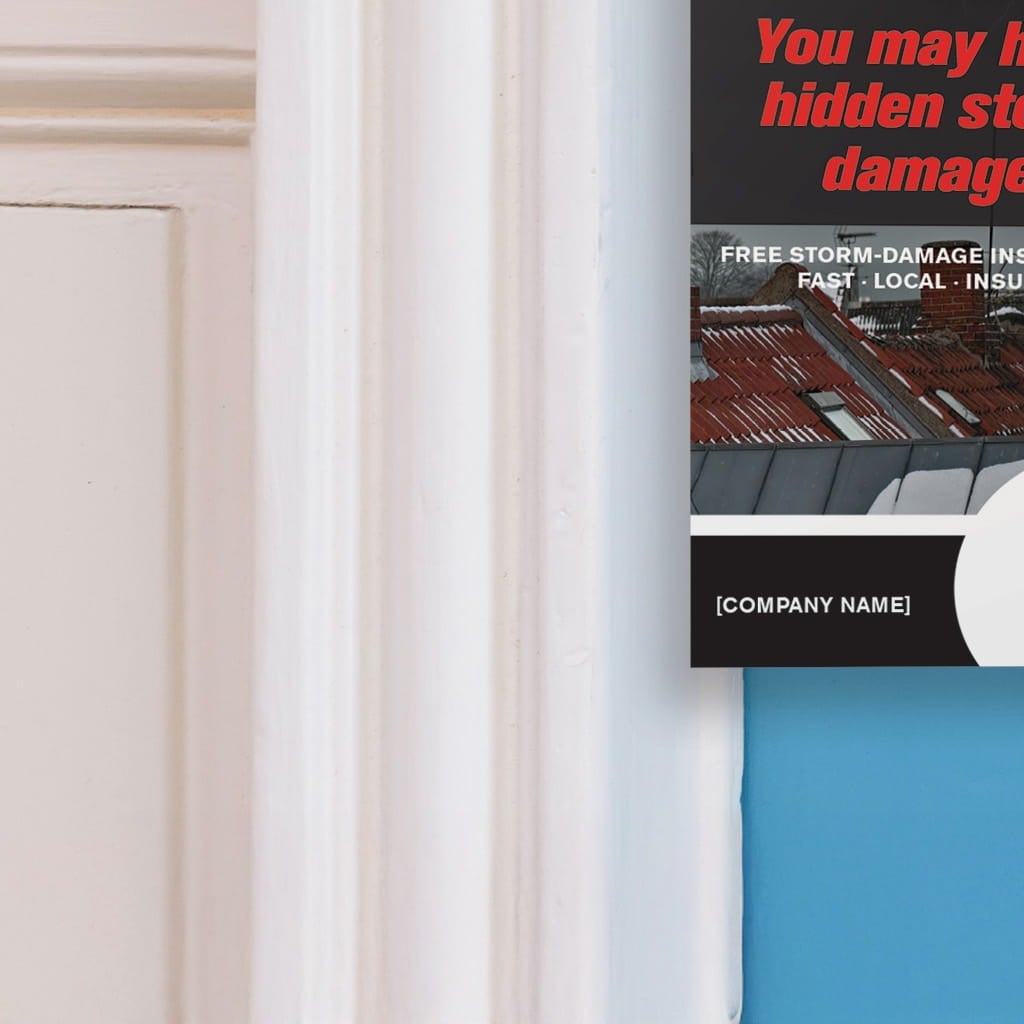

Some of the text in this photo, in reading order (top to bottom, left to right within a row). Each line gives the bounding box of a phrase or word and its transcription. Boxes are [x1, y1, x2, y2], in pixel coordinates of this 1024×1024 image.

[758, 18, 854, 65] You
[866, 29, 987, 78] may
[760, 81, 945, 129] hidden
[721, 245, 783, 263] FREE
[789, 246, 983, 264] STORM-DAMAGE
[798, 272, 855, 289] FAST
[874, 272, 947, 290] LOCAL
[717, 595, 910, 617] [COMPANY NAME]
